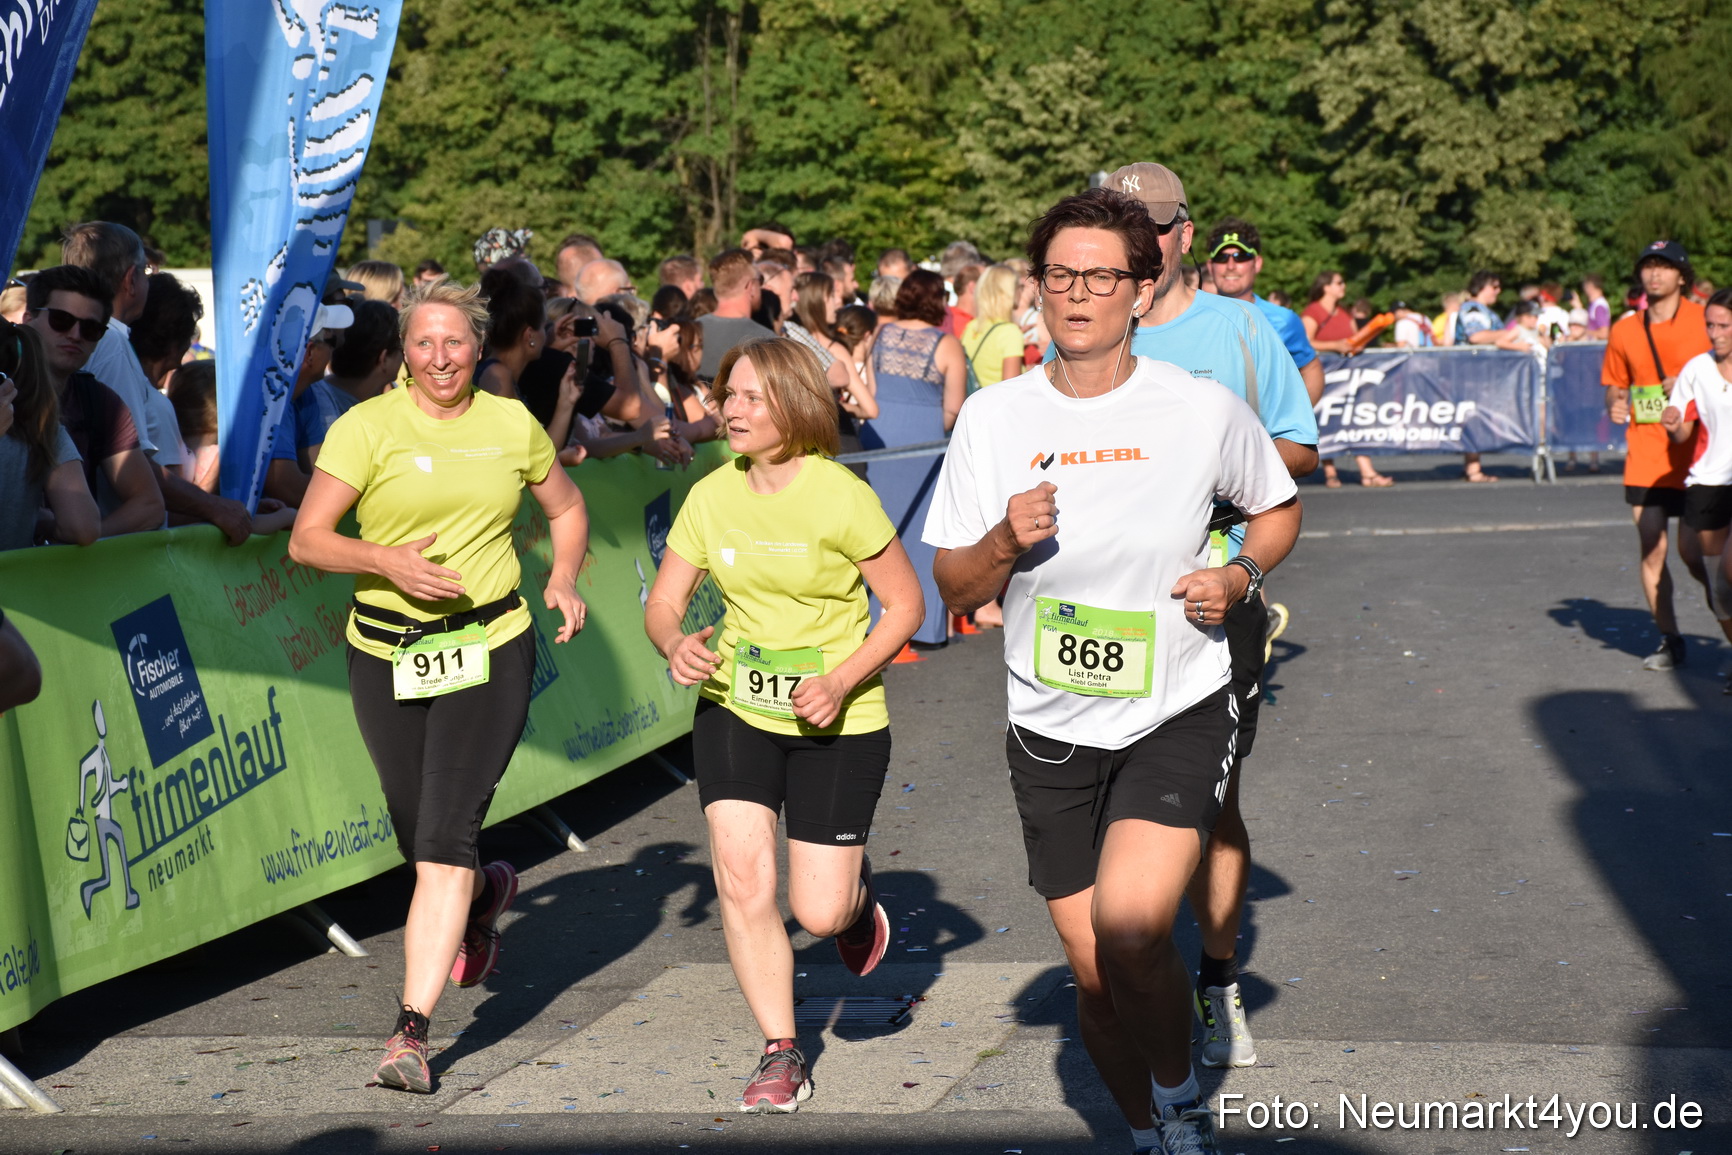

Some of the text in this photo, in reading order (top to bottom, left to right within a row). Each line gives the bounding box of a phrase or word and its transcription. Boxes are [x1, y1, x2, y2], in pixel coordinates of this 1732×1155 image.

[1122, 175, 1141, 194] NY
[1319, 393, 1476, 426] Fischer
[1638, 396, 1669, 412] 149
[1334, 427, 1462, 443] AUTOMOBILE
[1061, 448, 1150, 465] KLEBL
[1051, 612, 1089, 627] firmenlauf
[1092, 628, 1115, 636] 2018
[743, 651, 771, 666] firmenlauf
[1058, 633, 1124, 672] 868
[137, 648, 180, 687] Fischer
[413, 648, 463, 678] 911
[421, 677, 442, 686] Brede
[1069, 668, 1111, 681] List Petra
[1070, 678, 1086, 686] Klebl
[1087, 680, 1107, 688] GmbH
[150, 672, 184, 700] AUTOMOBILE
[748, 670, 802, 700] 917
[751, 694, 792, 707] Eimer Rena
[129, 685, 287, 862] firmenlauf
[260, 803, 392, 885] www.firmenlauf-ob
[835, 832, 857, 841] adidas
[148, 823, 214, 892] neumarkt
